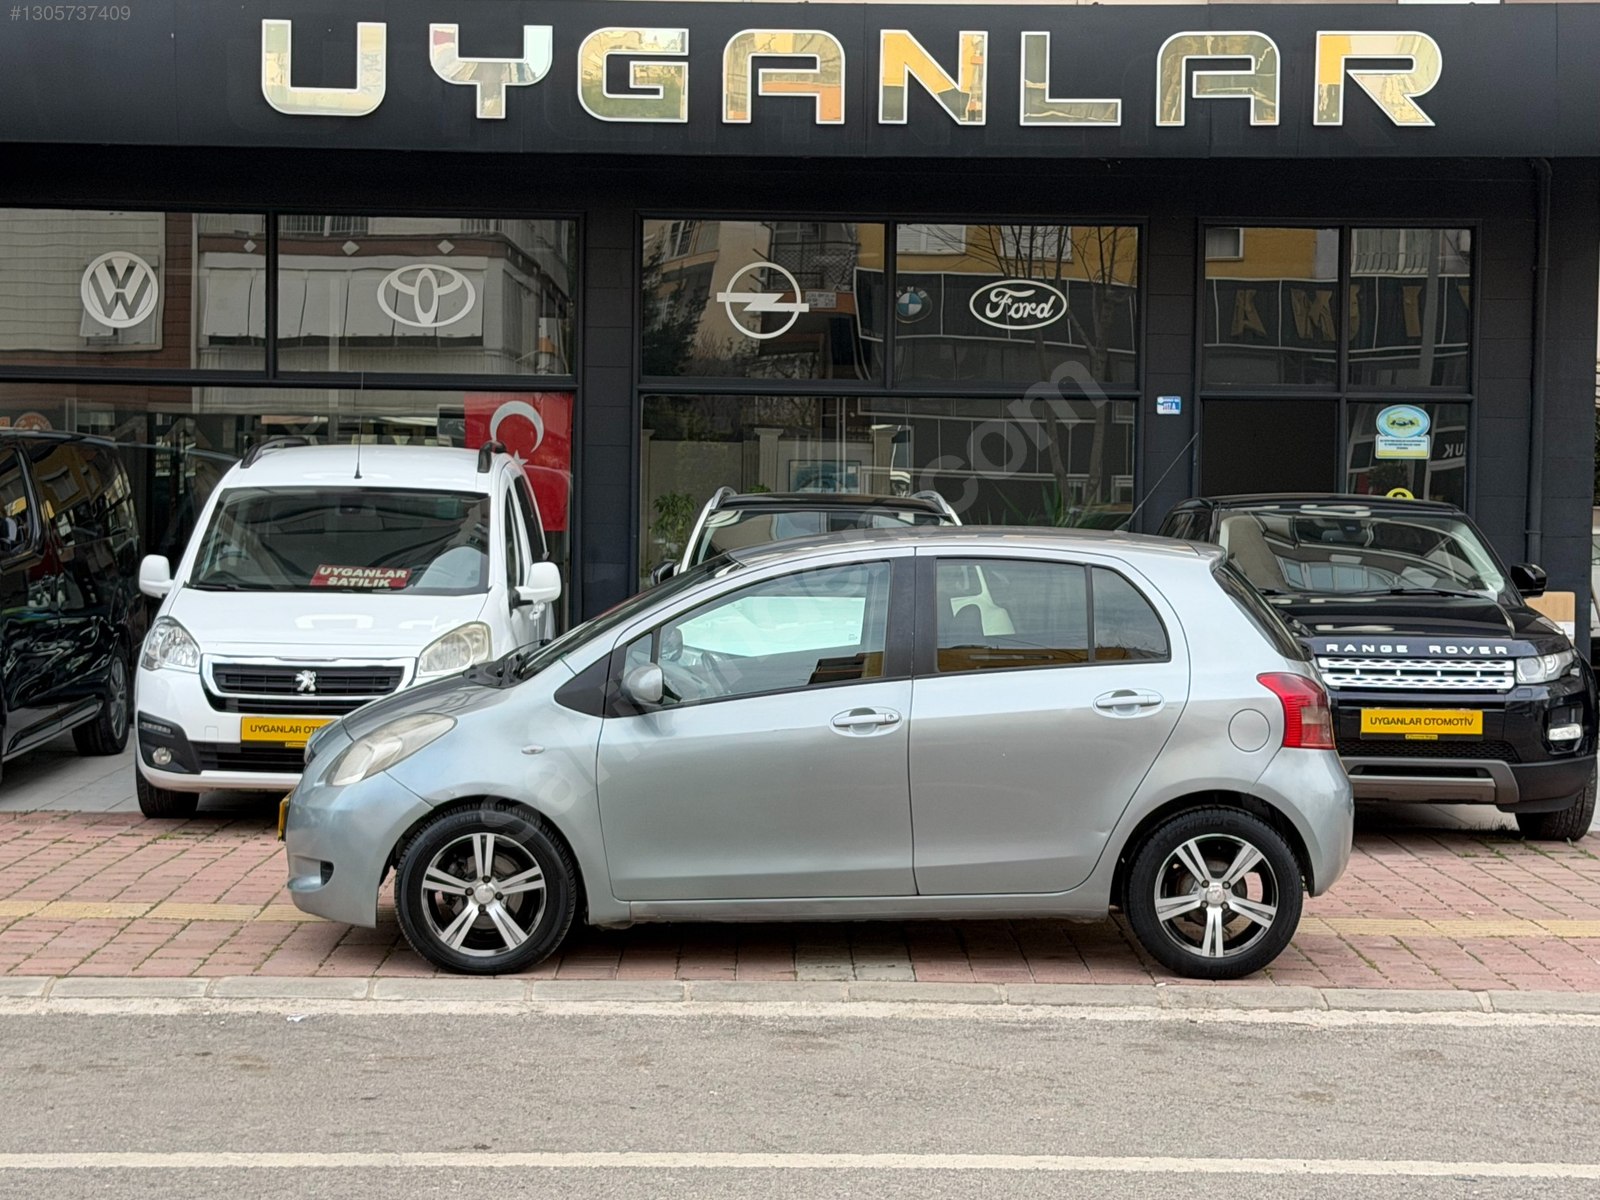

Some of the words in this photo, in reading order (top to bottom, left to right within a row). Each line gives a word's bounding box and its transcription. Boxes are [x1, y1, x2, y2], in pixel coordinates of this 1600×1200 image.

[261, 19, 1443, 127] UYGANLAR
[984, 287, 1057, 319] Ford
[318, 566, 408, 579] UYGANLAR
[327, 576, 392, 588] SATILIK
[1325, 643, 1409, 654] RANGE
[1428, 645, 1509, 655] ROVER
[1370, 717, 1422, 726] UYGANLAR
[1423, 716, 1475, 727] OTOMOTİV
[250, 724, 302, 734] UYGANLAR
